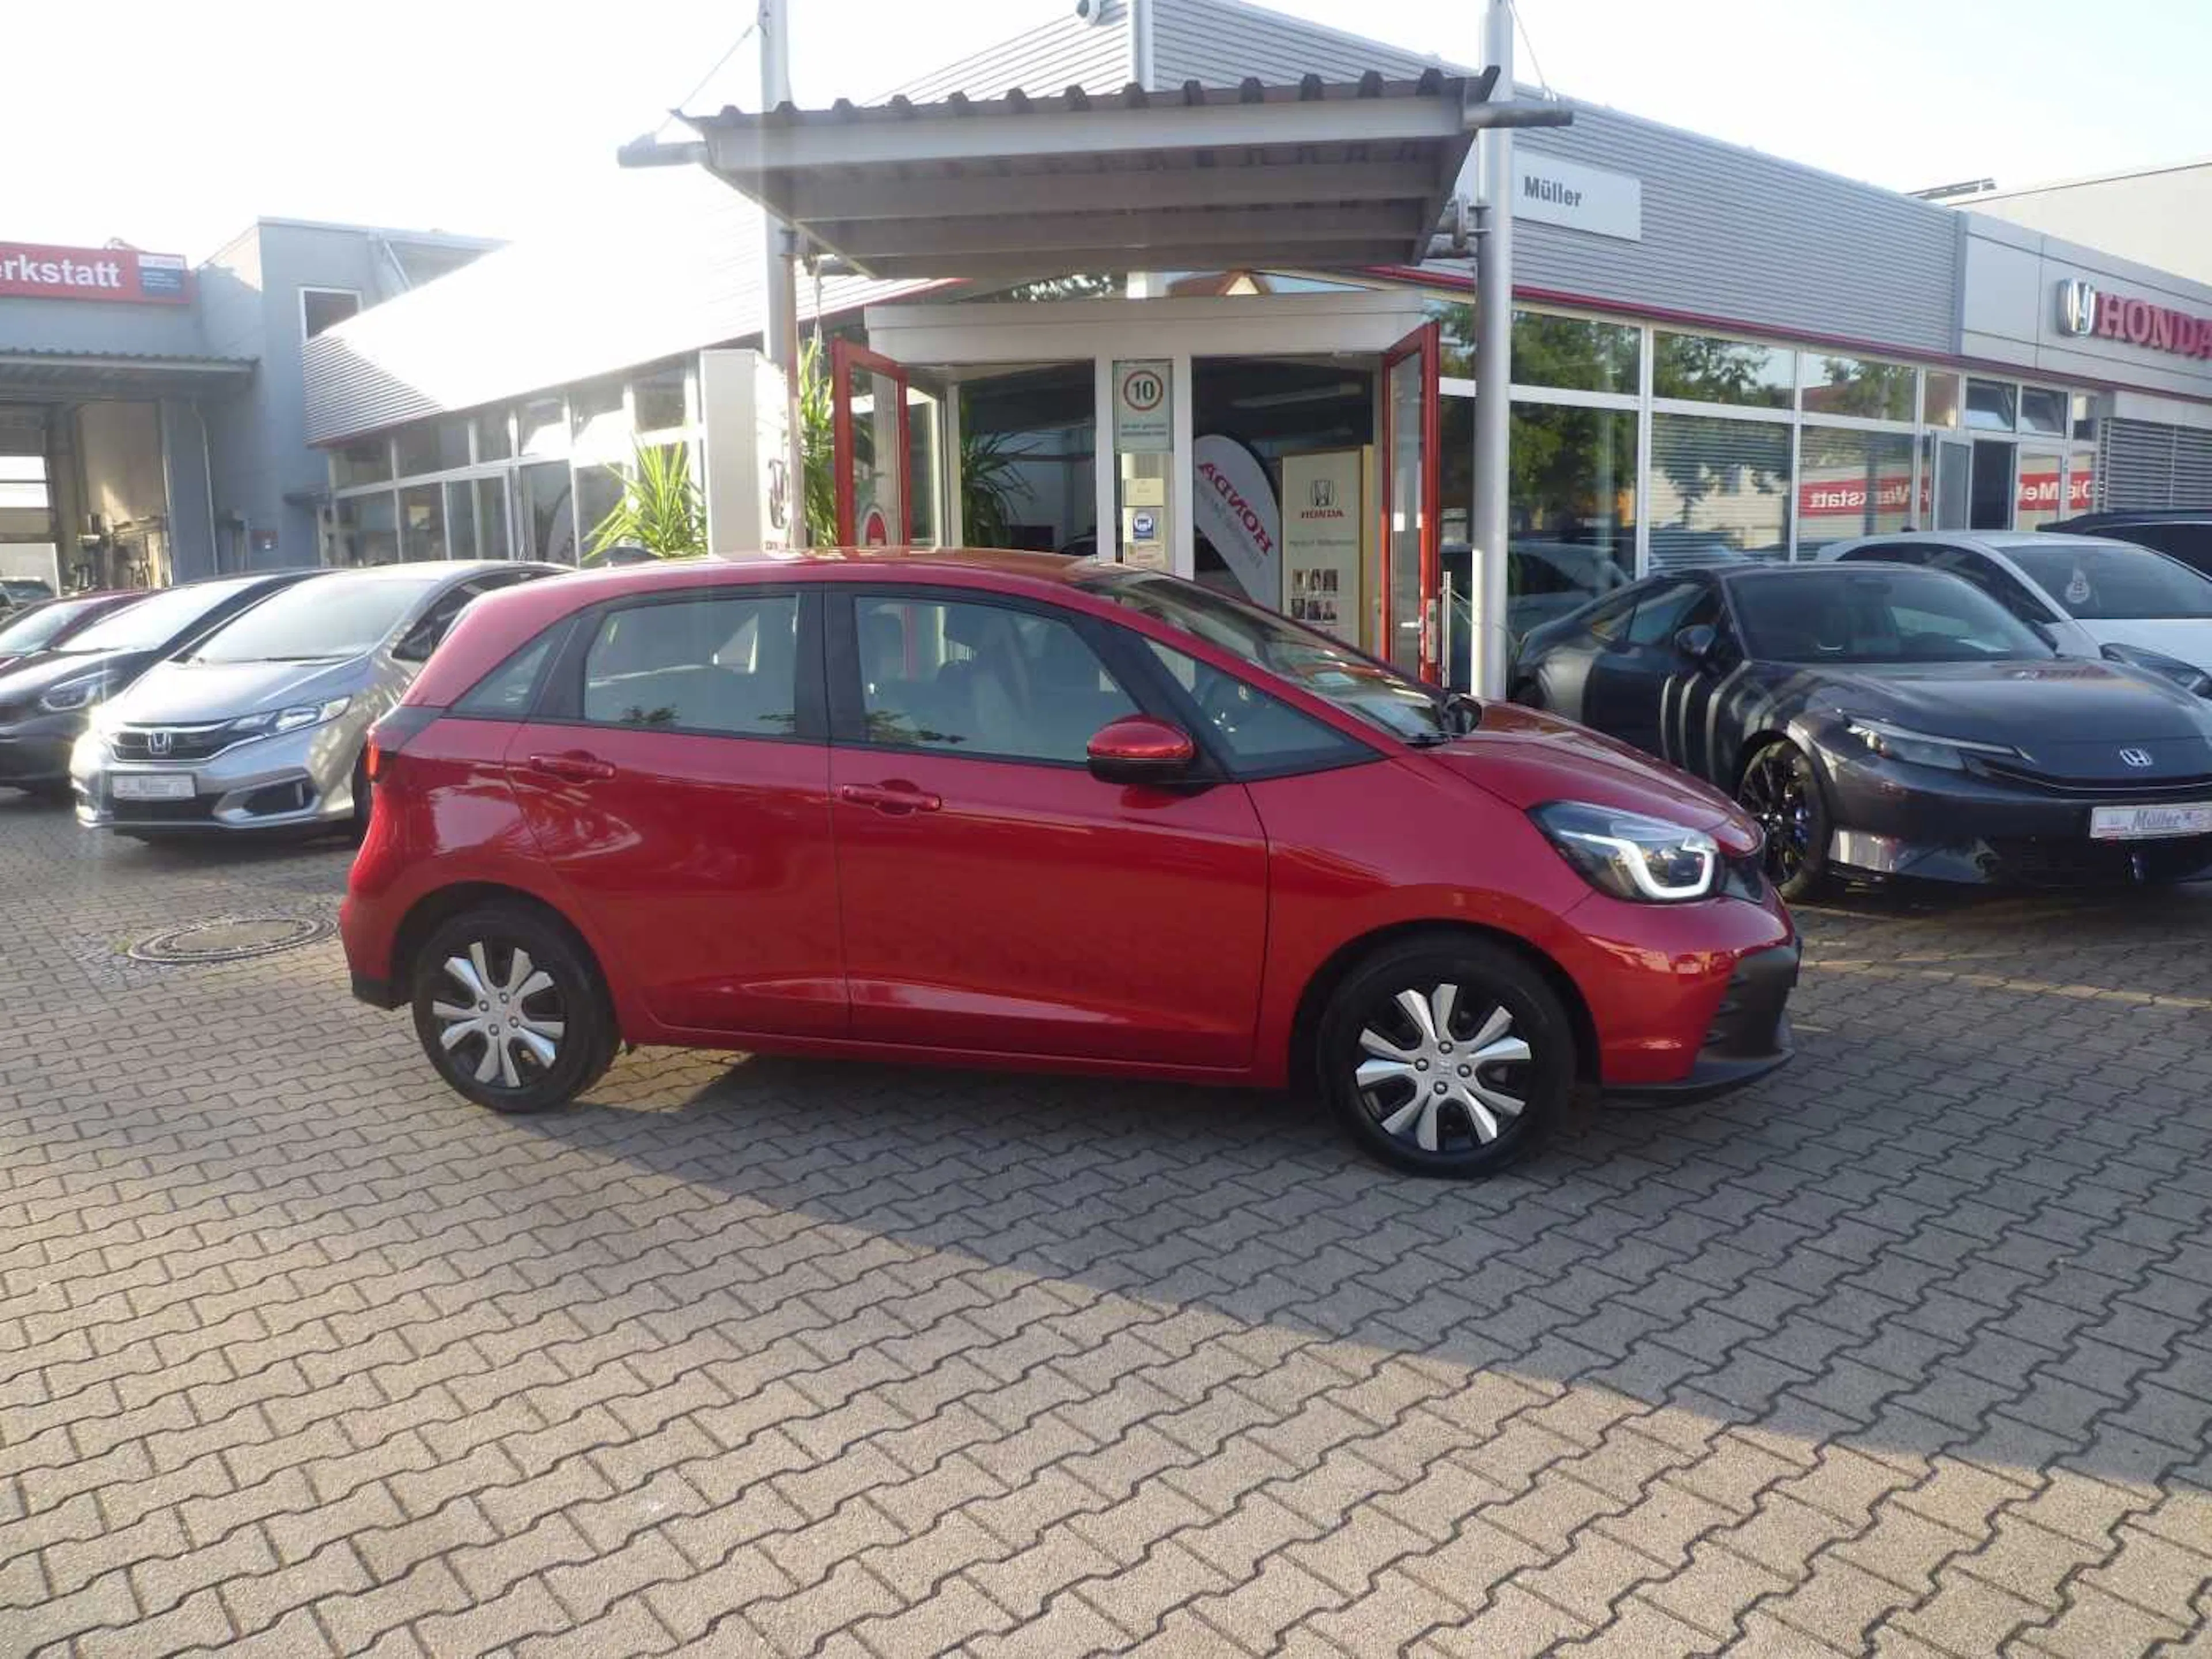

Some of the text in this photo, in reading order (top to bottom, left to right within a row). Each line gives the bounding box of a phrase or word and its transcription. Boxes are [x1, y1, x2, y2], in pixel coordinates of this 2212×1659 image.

[1524, 175, 1582, 207] Müller
[0, 253, 122, 287] rkstatt
[1131, 380, 1155, 400] 10
